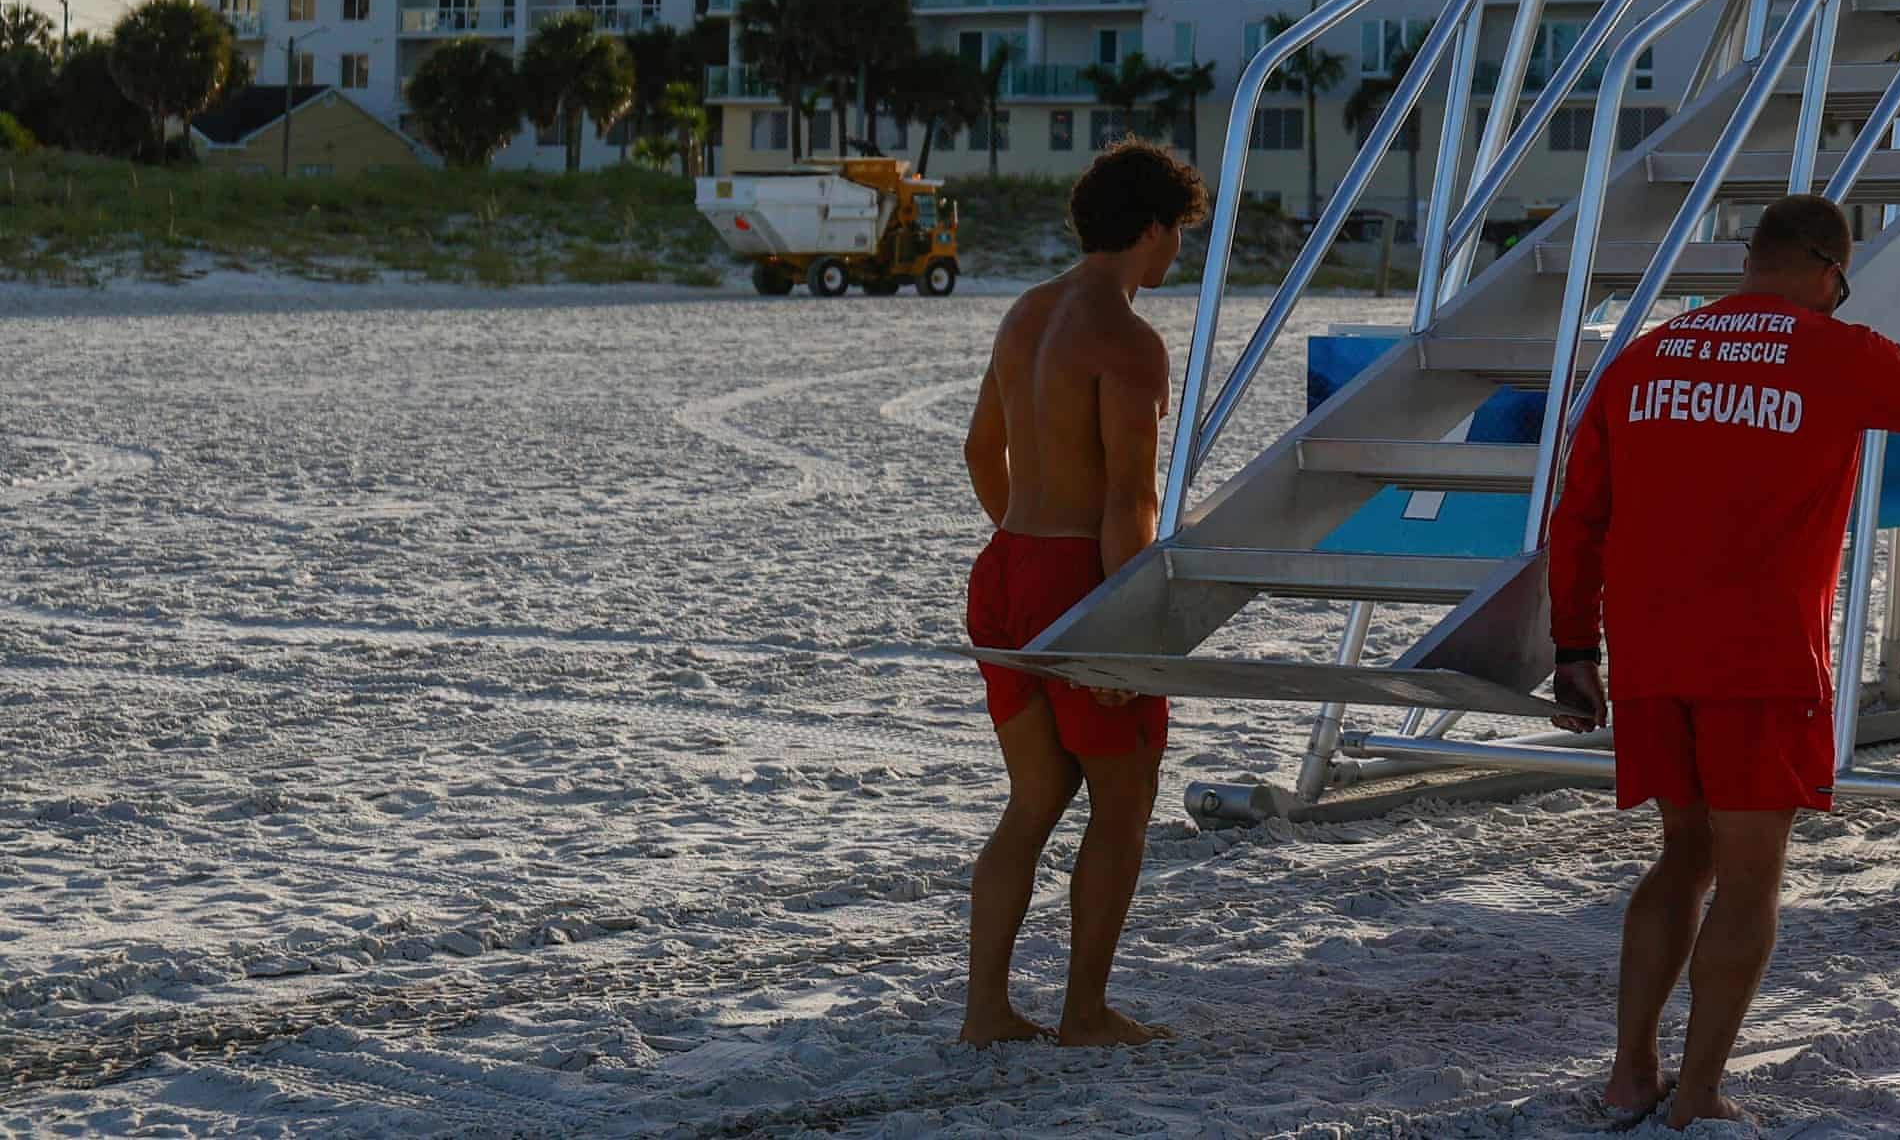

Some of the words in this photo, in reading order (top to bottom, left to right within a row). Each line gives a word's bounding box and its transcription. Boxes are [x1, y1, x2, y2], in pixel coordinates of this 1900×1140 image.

[1669, 313, 1796, 334] CLEARWATER
[1656, 339, 1696, 358] FIRE
[1698, 341, 1712, 360] &
[1717, 341, 1788, 364] RESCUE
[1628, 379, 1803, 434] LIFEGUARD
